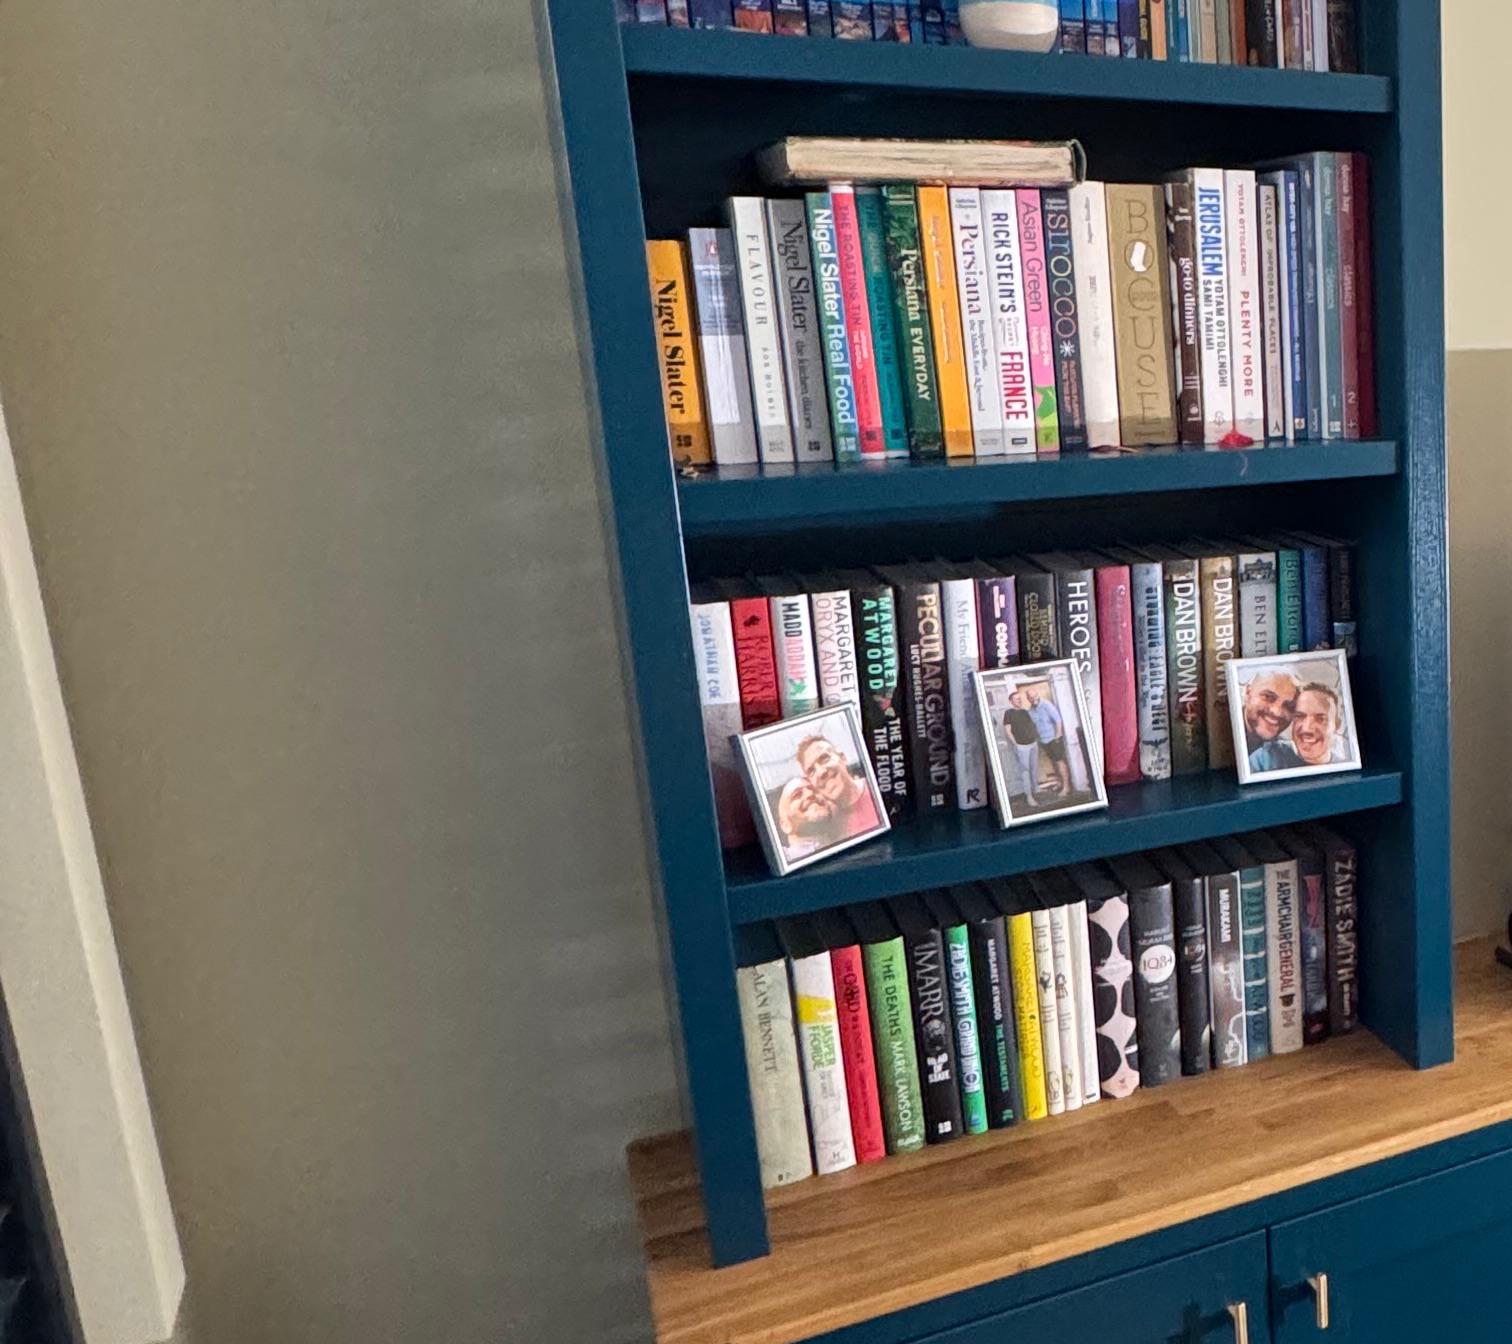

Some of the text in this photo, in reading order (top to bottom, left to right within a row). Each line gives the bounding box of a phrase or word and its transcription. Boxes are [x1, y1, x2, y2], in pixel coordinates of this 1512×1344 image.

[866, 206, 879, 230] THE
[991, 213, 1016, 313] RICK STEIN'S
[1022, 201, 1044, 313] Asian Green
[1198, 187, 1223, 276] JERUSALEM
[1237, 184, 1247, 276] YOTAM OTTOLENGHI
[746, 234, 768, 326] FLAVOUR
[839, 205, 861, 326] THE ROASTING TIN
[874, 277, 889, 342] ROASTING
[960, 224, 984, 315] Persiana
[1179, 257, 1196, 345] go-to dinners
[1264, 194, 1277, 354] ATLAS OF IMPROBABLE PLACES
[1343, 265, 1353, 307] classics
[654, 279, 687, 414] Nigel Slater
[778, 221, 813, 430] Nigel Slater the kitchen diaries
[812, 208, 857, 424] Nigel Slater Real Food
[881, 345, 893, 365] TIN
[900, 248, 930, 401] Persiana EVERYDAY
[1124, 198, 1161, 424] BOCUSE
[1203, 280, 1214, 350] SAMI TAMIMI
[1215, 280, 1228, 387] YOTAM OTTOLENGHI
[1240, 291, 1253, 397] PLENTY MORE
[1000, 351, 1028, 420] FRANCE
[816, 598, 834, 645] ORYX
[832, 597, 856, 692] MARGARET
[862, 599, 884, 690] ATWOOD
[878, 596, 896, 688] MARGARET
[953, 600, 968, 620] My
[1068, 581, 1091, 672] HEROES
[1145, 587, 1162, 648] STORMING
[1173, 583, 1198, 702] DAN BROWN
[1212, 577, 1233, 696] DAN BROWN
[1254, 596, 1265, 625] BEN
[1286, 559, 1300, 641] Ben Elton
[698, 615, 720, 699] JONATHAN COE
[737, 636, 757, 706] HARRIS
[755, 635, 776, 704] ROBERT
[820, 650, 839, 687] AND
[910, 644, 921, 665] LUCY
[916, 593, 949, 785] PECULIAR GROUND
[873, 727, 891, 792] THE FLOOD
[888, 718, 907, 796] THE YEAR OF
[1151, 705, 1168, 731] NEST
[1219, 888, 1231, 943] MURAKAMI
[1334, 861, 1354, 981] ZADIE SMITH
[751, 970, 777, 1072] ALAN BENNETT
[914, 952, 944, 1022] MARR
[987, 939, 1009, 1091] MARGARET ATWOOD THE TESTAMENTS
[809, 1026, 825, 1070] FFORDE
[820, 1025, 836, 1066] JASPER
[881, 955, 912, 1131] THE DEATHS MARK LAWSON
